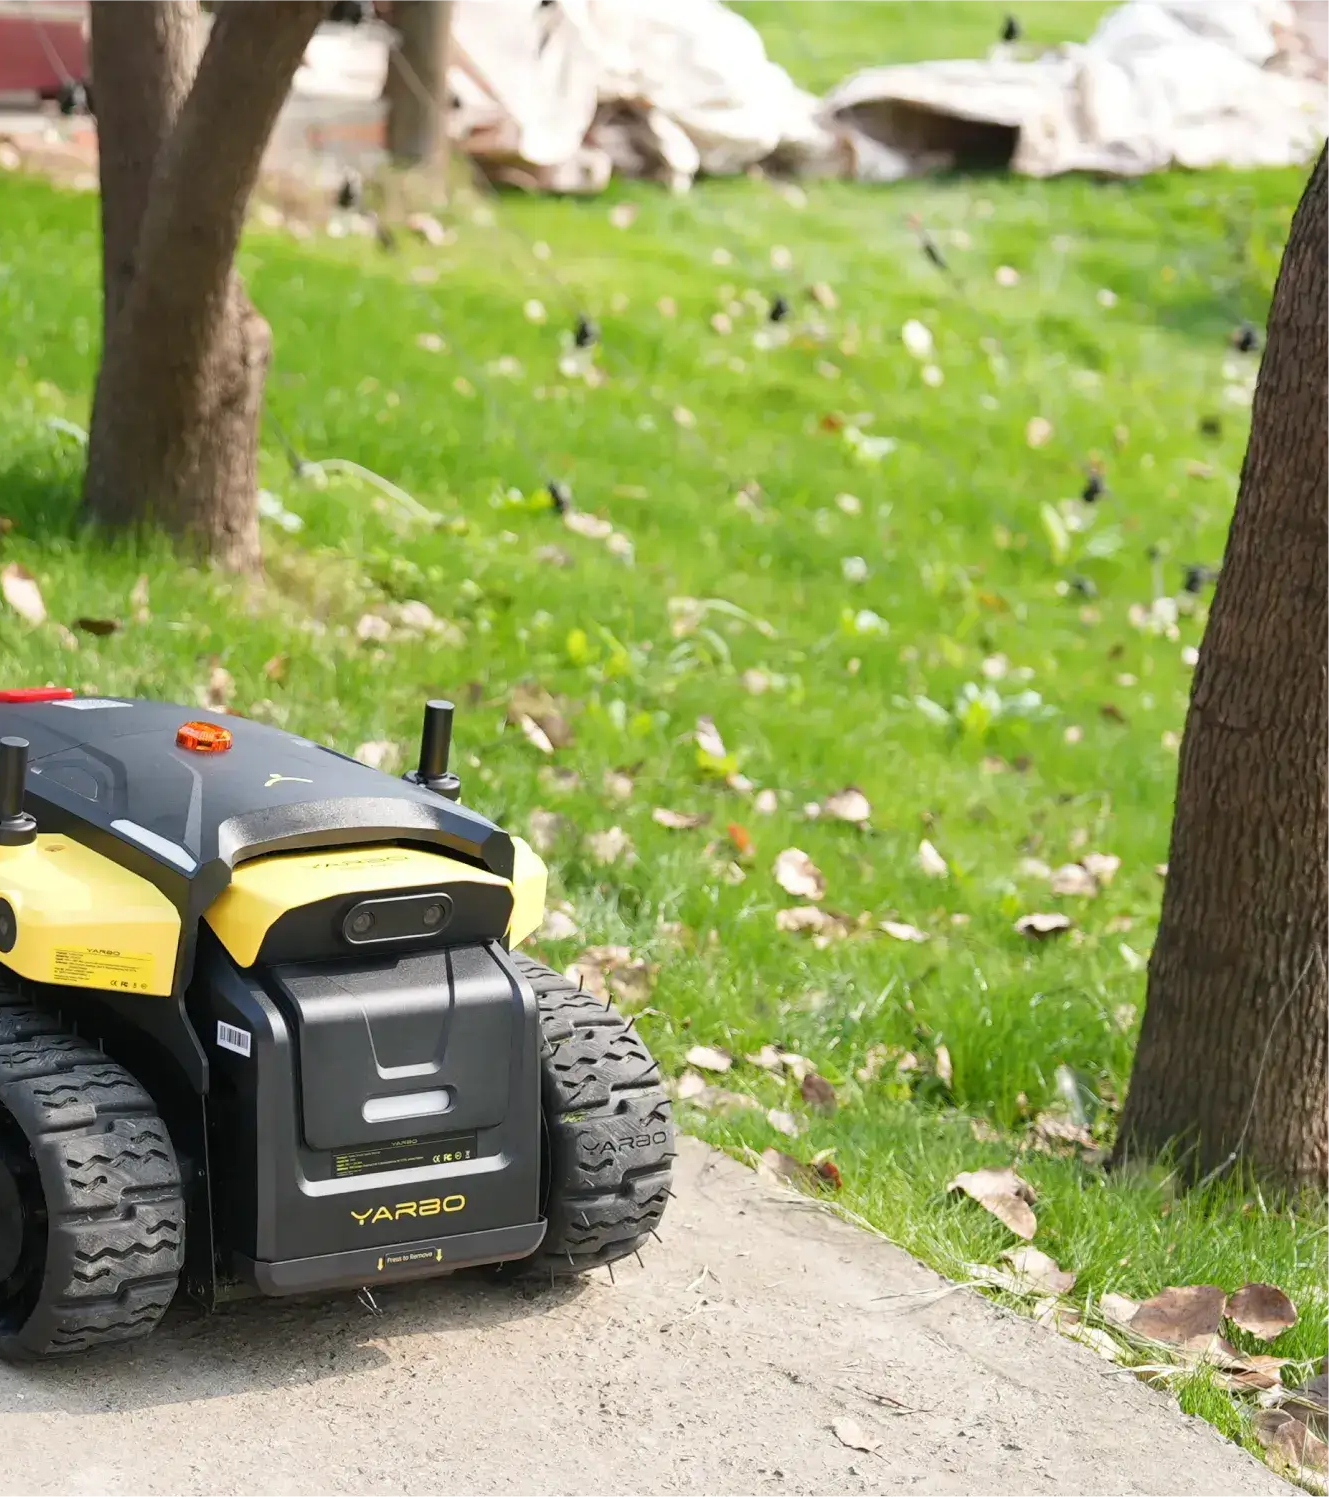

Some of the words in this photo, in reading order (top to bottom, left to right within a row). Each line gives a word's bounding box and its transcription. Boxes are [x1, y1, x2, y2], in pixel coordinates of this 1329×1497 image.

[86, 948, 120, 956] YARBO
[391, 1138, 418, 1147] YARBO
[582, 1131, 667, 1156] YARBO
[351, 1194, 466, 1226] YARBO
[386, 1256, 402, 1264] Press
[410, 1251, 433, 1261] Remove
